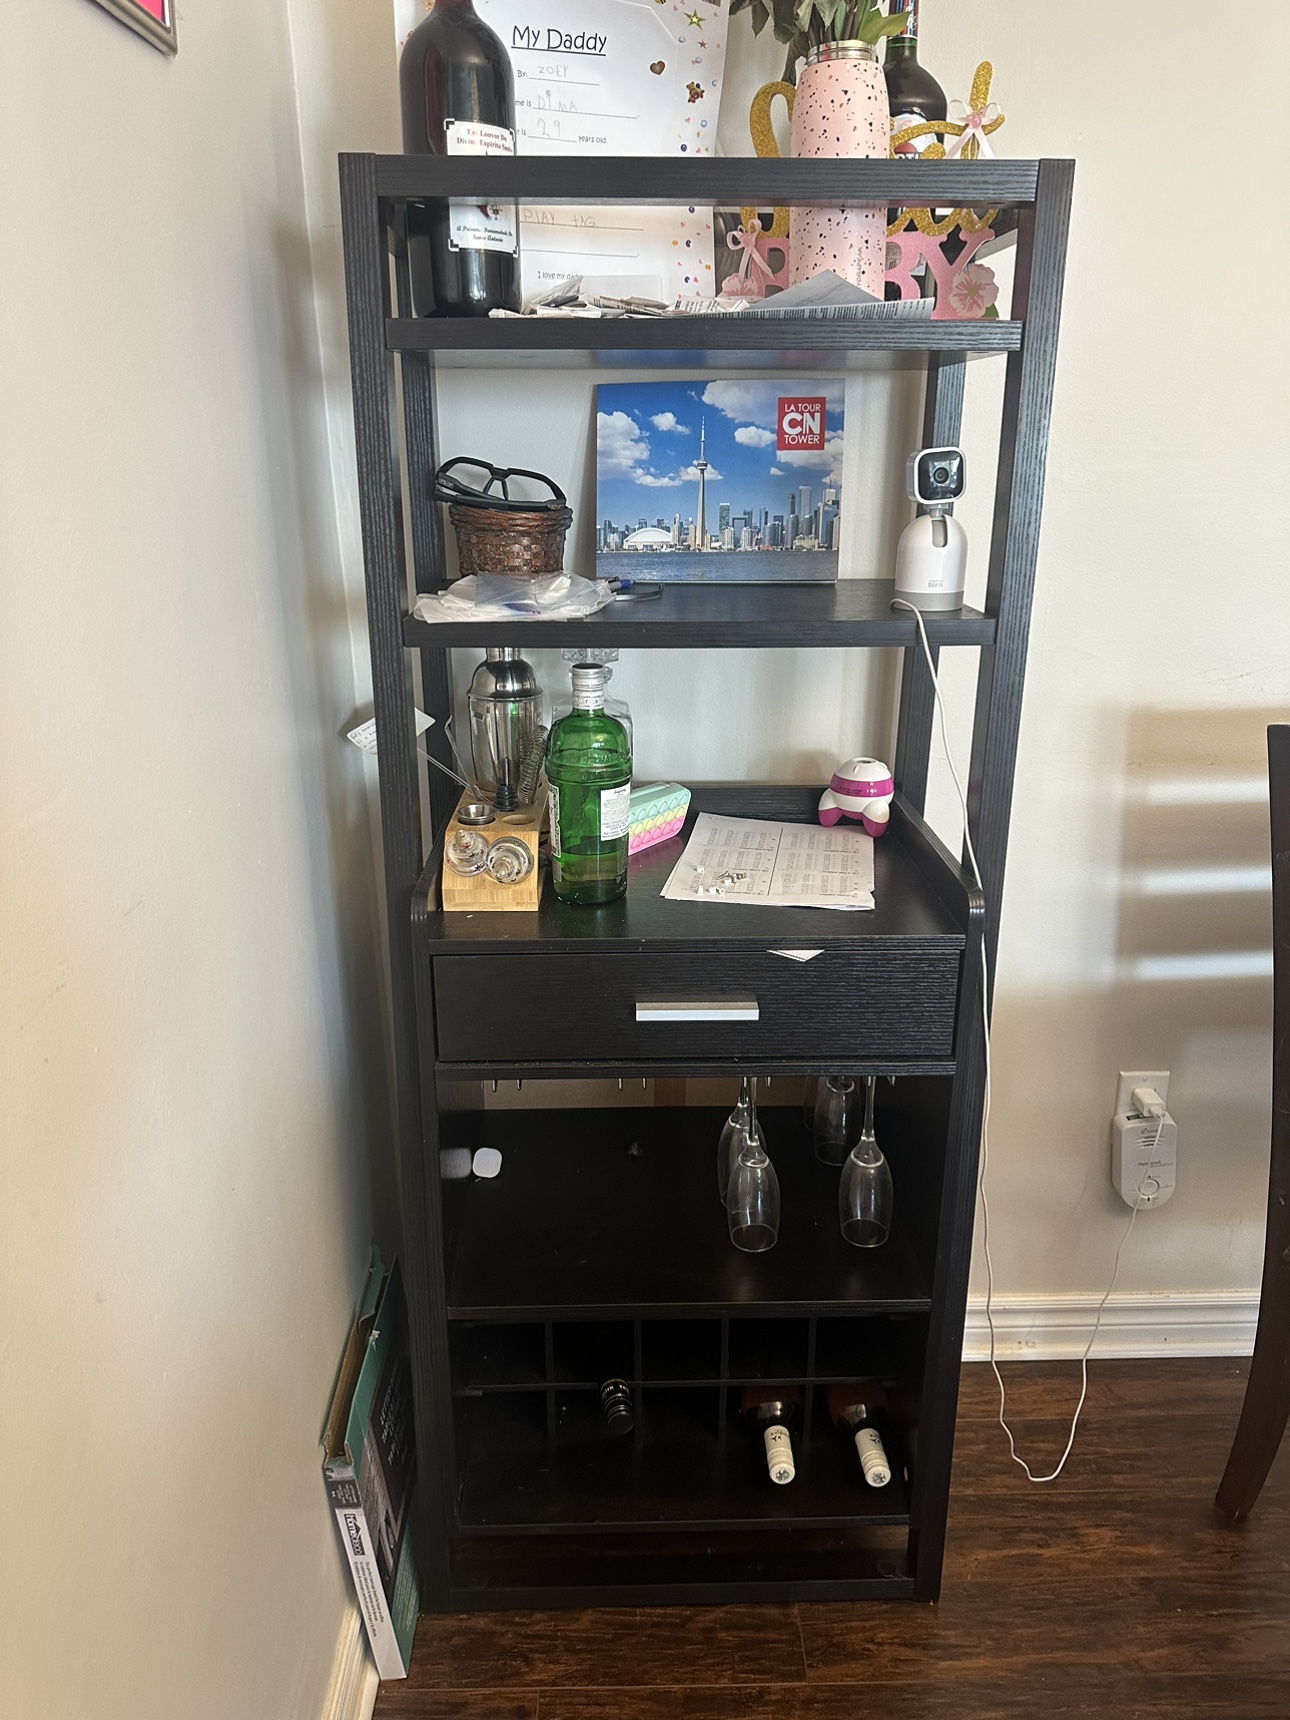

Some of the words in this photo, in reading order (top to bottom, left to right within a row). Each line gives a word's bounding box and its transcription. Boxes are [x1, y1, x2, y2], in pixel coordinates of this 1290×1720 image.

[512, 25, 540, 48] My
[547, 28, 607, 53] Daddy
[537, 118, 560, 138] 29
[578, 135, 594, 144] years
[542, 271, 555, 280] love
[784, 403, 796, 412] LA
[797, 403, 821, 412] TOUR
[782, 412, 821, 435] CN
[784, 434, 820, 445] TOWER
